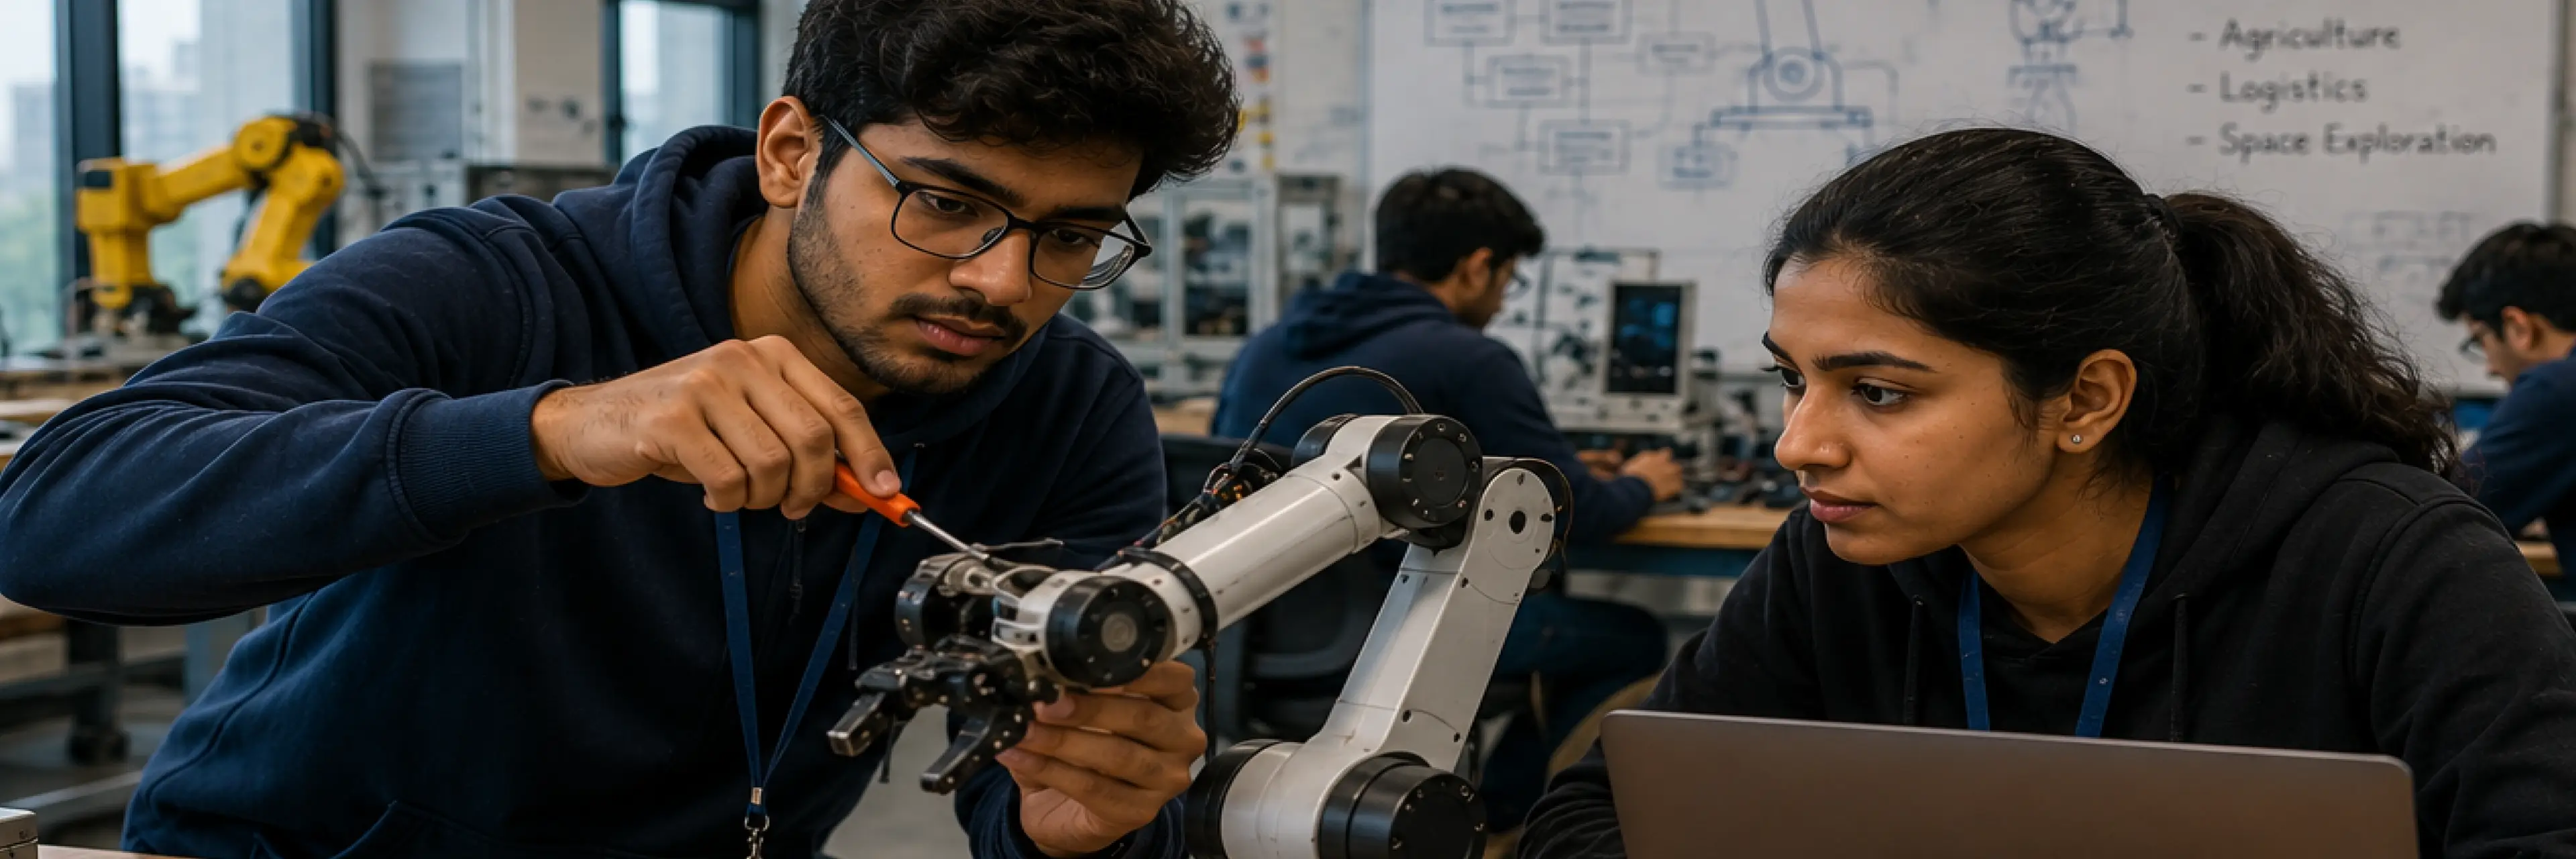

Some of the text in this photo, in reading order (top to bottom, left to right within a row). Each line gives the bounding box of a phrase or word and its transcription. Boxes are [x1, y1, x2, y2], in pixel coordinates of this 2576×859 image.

[2219, 19, 2401, 61] Agriculture
[2219, 73, 2368, 113] Logistics
[2219, 122, 2310, 164] Space
[2322, 123, 2497, 163] Exploration
